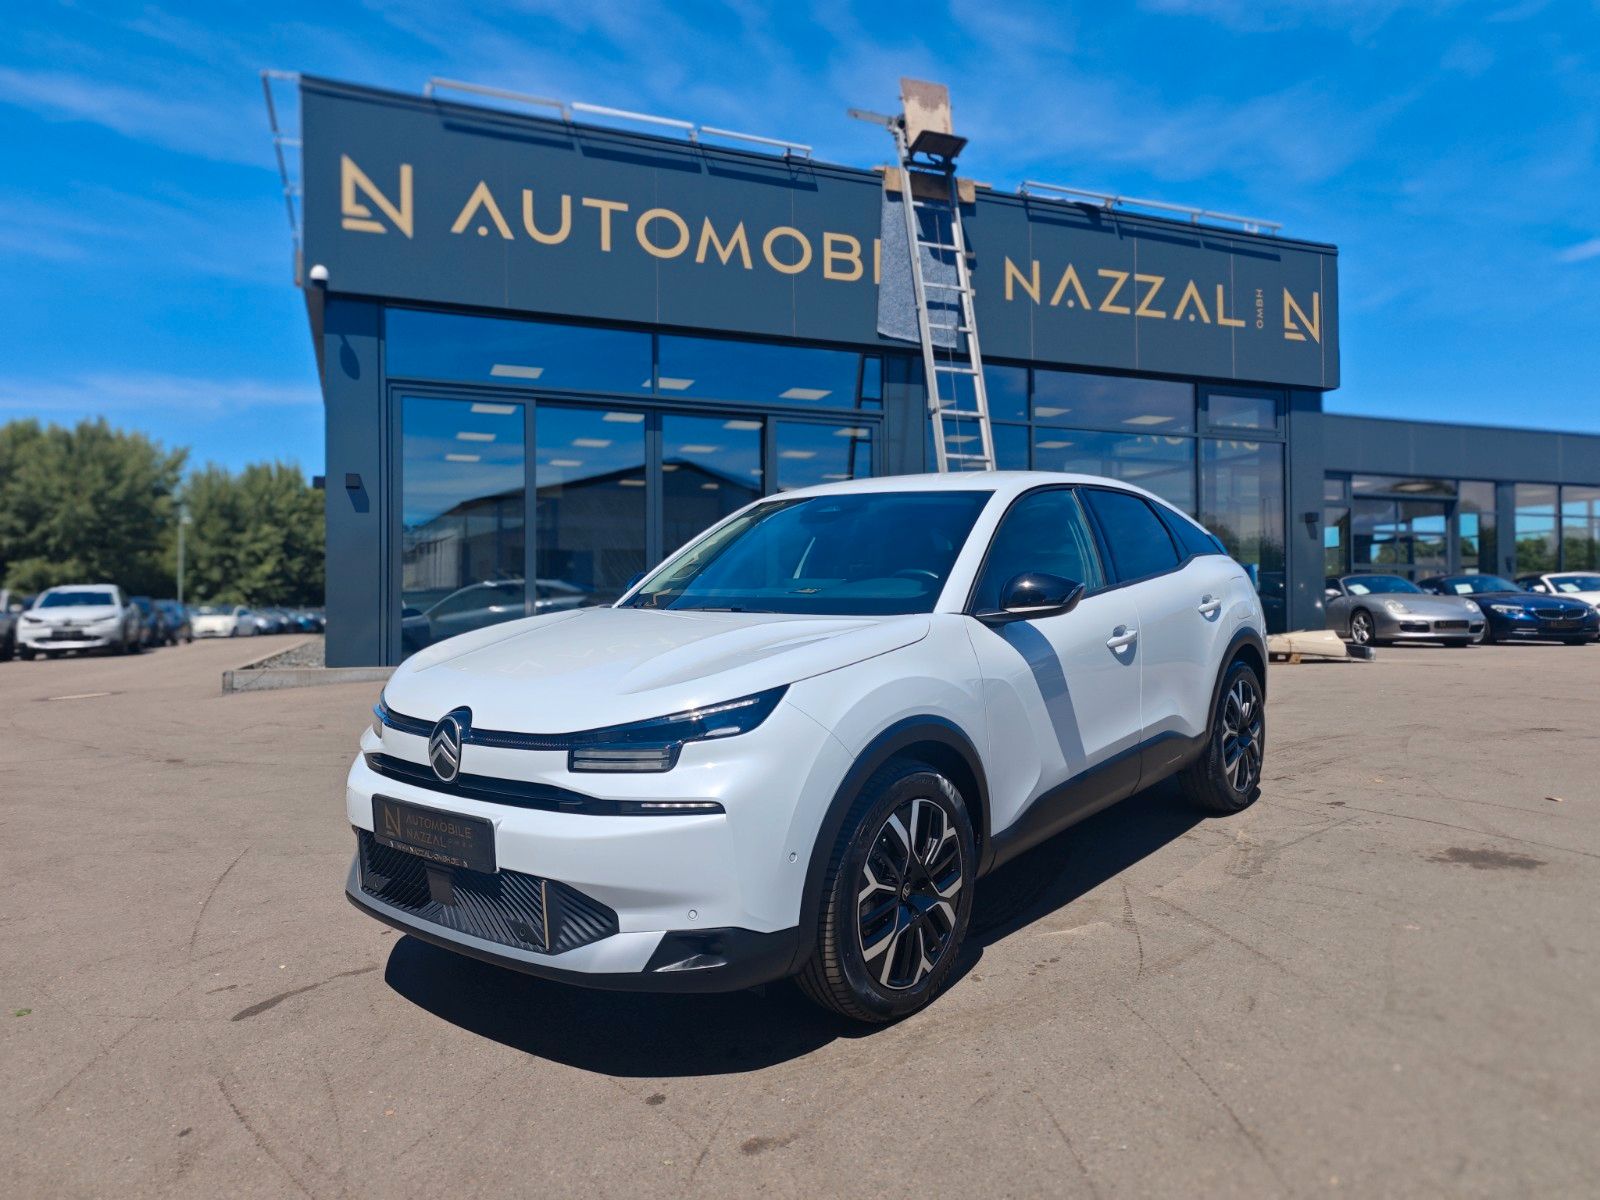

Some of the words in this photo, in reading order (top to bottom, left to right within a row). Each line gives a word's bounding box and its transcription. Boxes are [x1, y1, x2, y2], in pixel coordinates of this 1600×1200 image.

[451, 180, 975, 297] AUTOMOBI
[1004, 256, 1246, 328] NAZZAL
[405, 814, 472, 838] AUTOMOBILE
[406, 828, 446, 848] NAZZAL
